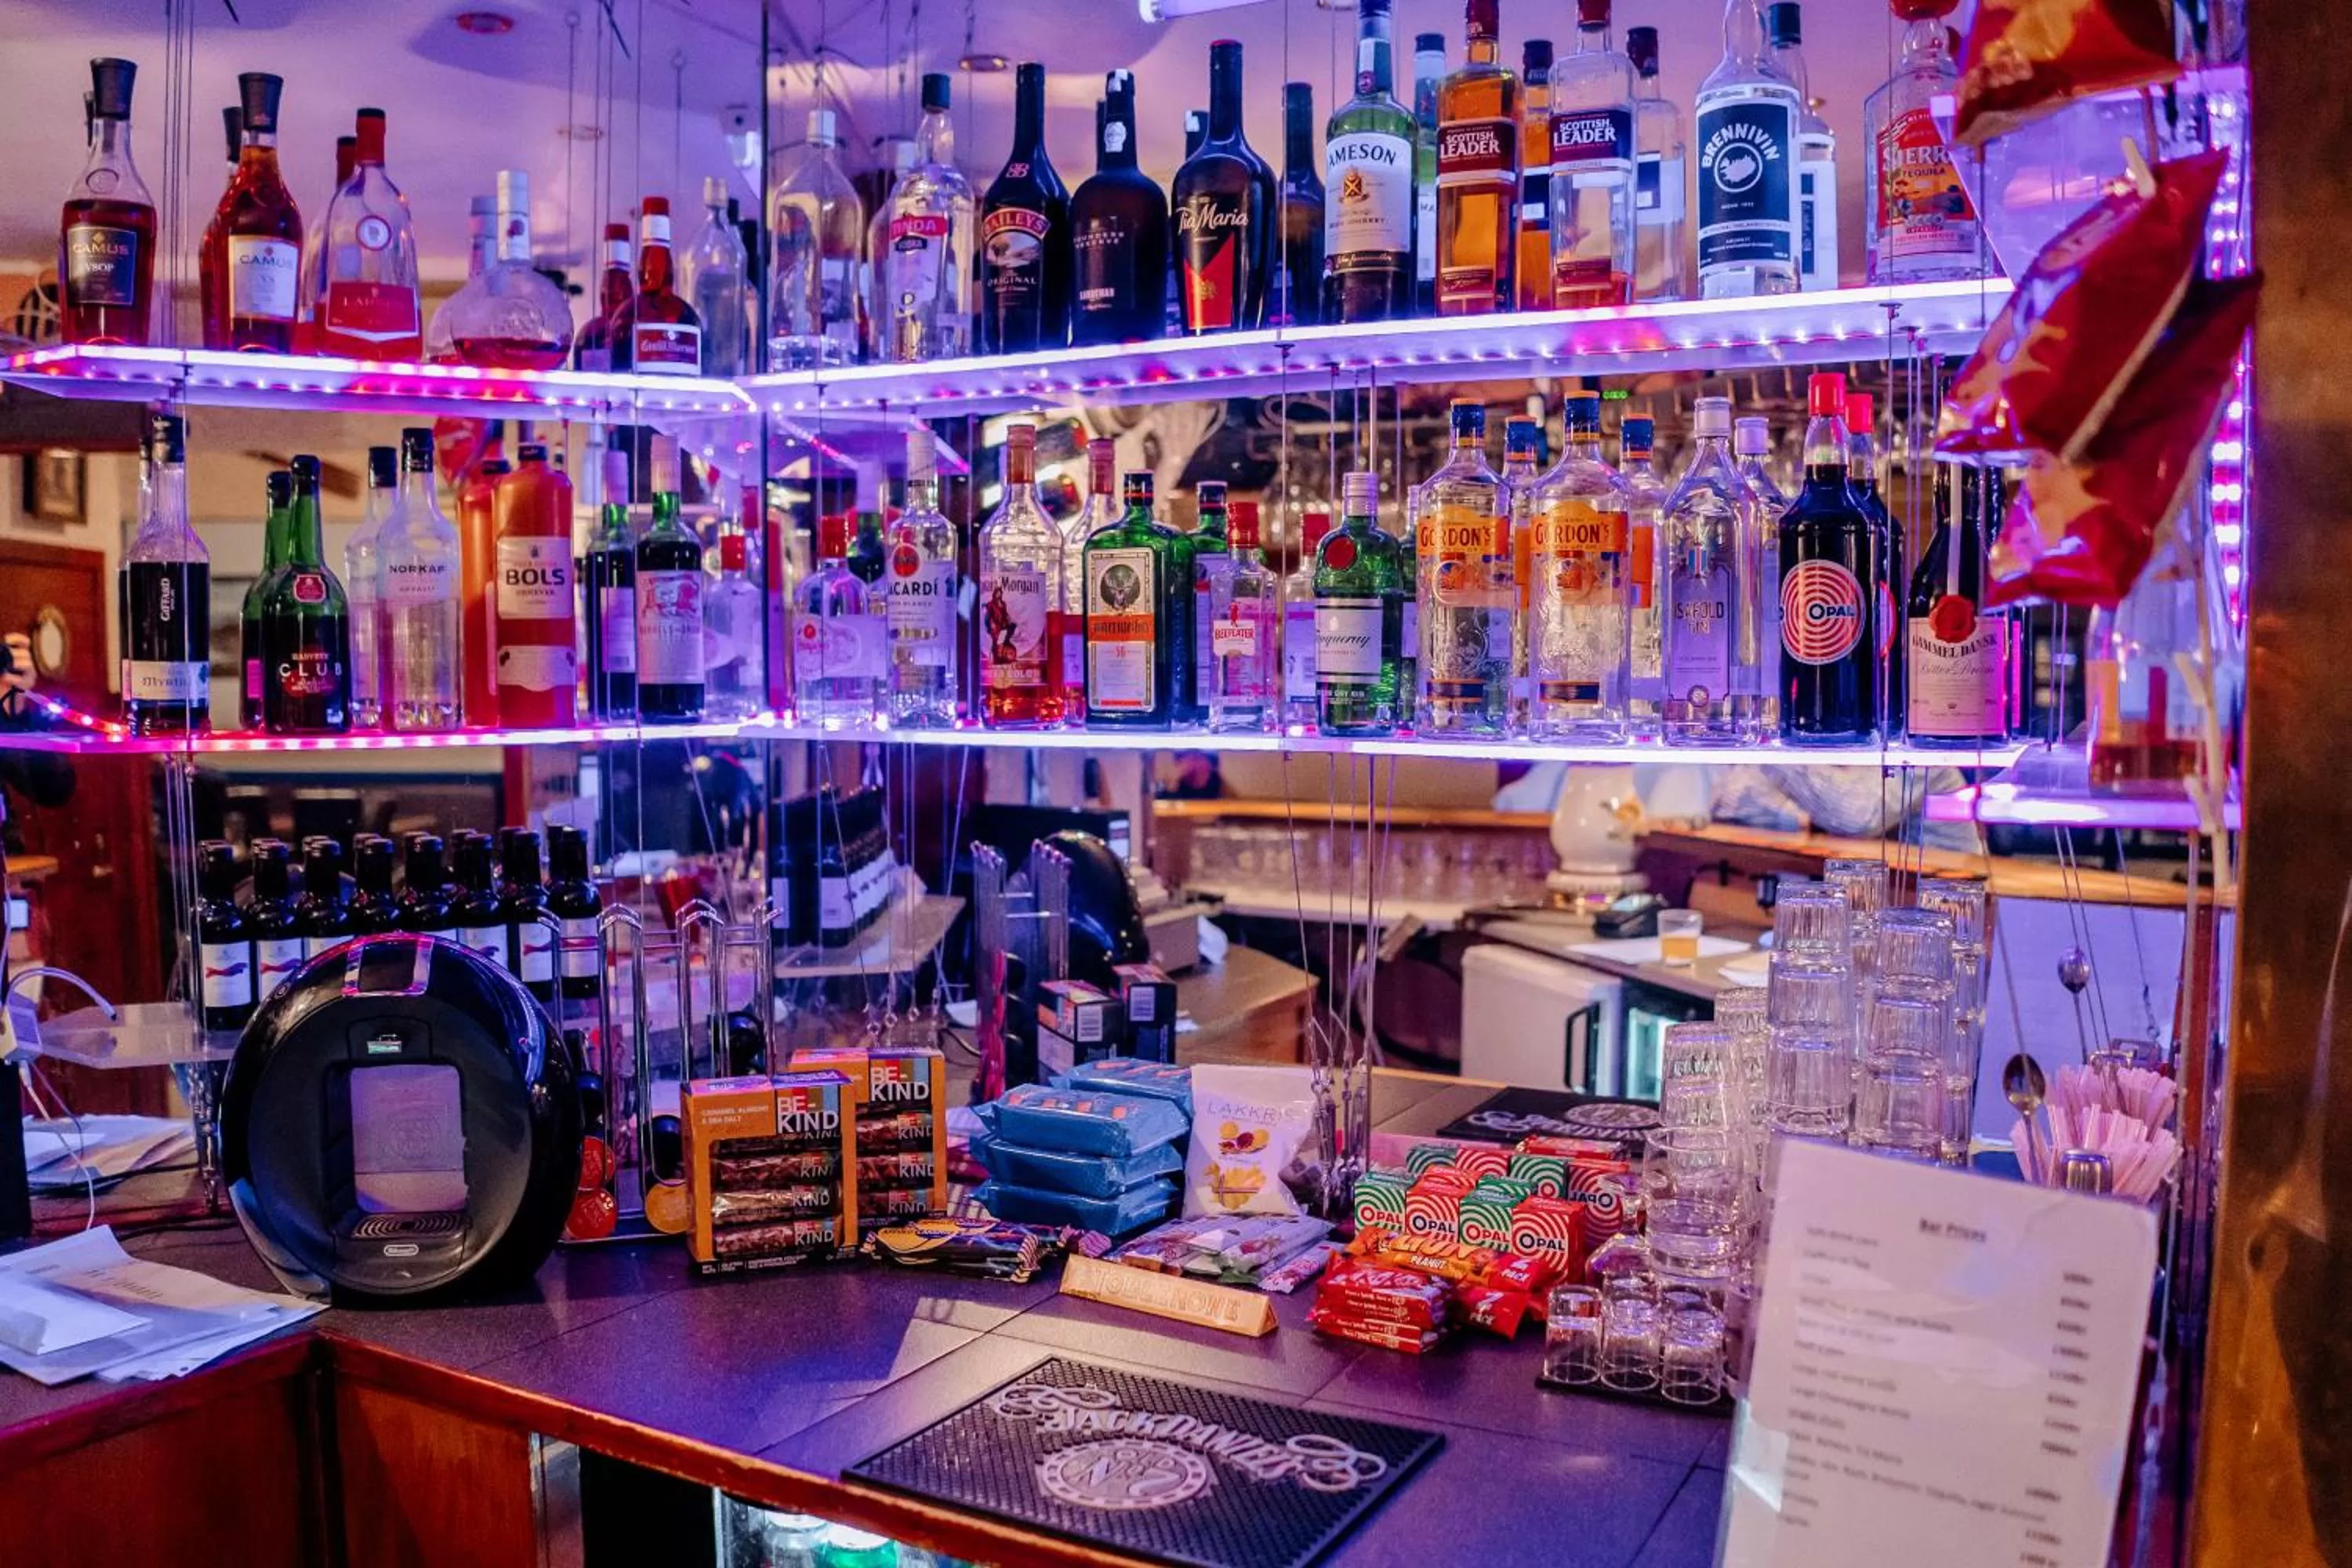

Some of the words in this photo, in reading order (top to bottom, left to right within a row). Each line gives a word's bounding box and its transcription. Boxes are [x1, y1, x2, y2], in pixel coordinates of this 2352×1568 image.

[1559, 118, 1610, 132] SCOTTISH
[1446, 131, 1494, 144] SCOTTISH
[1553, 126, 1617, 148] LEADER
[1328, 143, 1397, 167] AMESON
[1440, 140, 1501, 160] LEADER
[1883, 142, 1951, 170] SIERR
[1902, 167, 1947, 178] TEQUILA
[985, 212, 1046, 234] BAILEYS
[1195, 203, 1249, 228] Maria
[72, 241, 129, 256] CAMUS
[987, 276, 1038, 287] ORIGINAL
[506, 568, 565, 586] BOLS
[888, 577, 939, 597] ACARDÍ
[1000, 575, 1040, 595] Morgan
[1808, 603, 1857, 620] OPAL
[1214, 628, 1254, 640] BEEFEATER
[1911, 634, 1958, 658] GAMMEL
[871, 1080, 930, 1102] KIND
[777, 1110, 840, 1134] KIND
[898, 1125, 933, 1140] KIND
[899, 1163, 935, 1178] KIND
[1360, 1206, 1403, 1225] OPAL
[1412, 1214, 1457, 1234] OPAL
[794, 1229, 835, 1247] KIND
[1465, 1223, 1509, 1243] OPAL
[1519, 1232, 1566, 1253] OPAL
[1411, 1255, 1447, 1269] PEANUT
[1043, 1408, 1163, 1436] JACK
